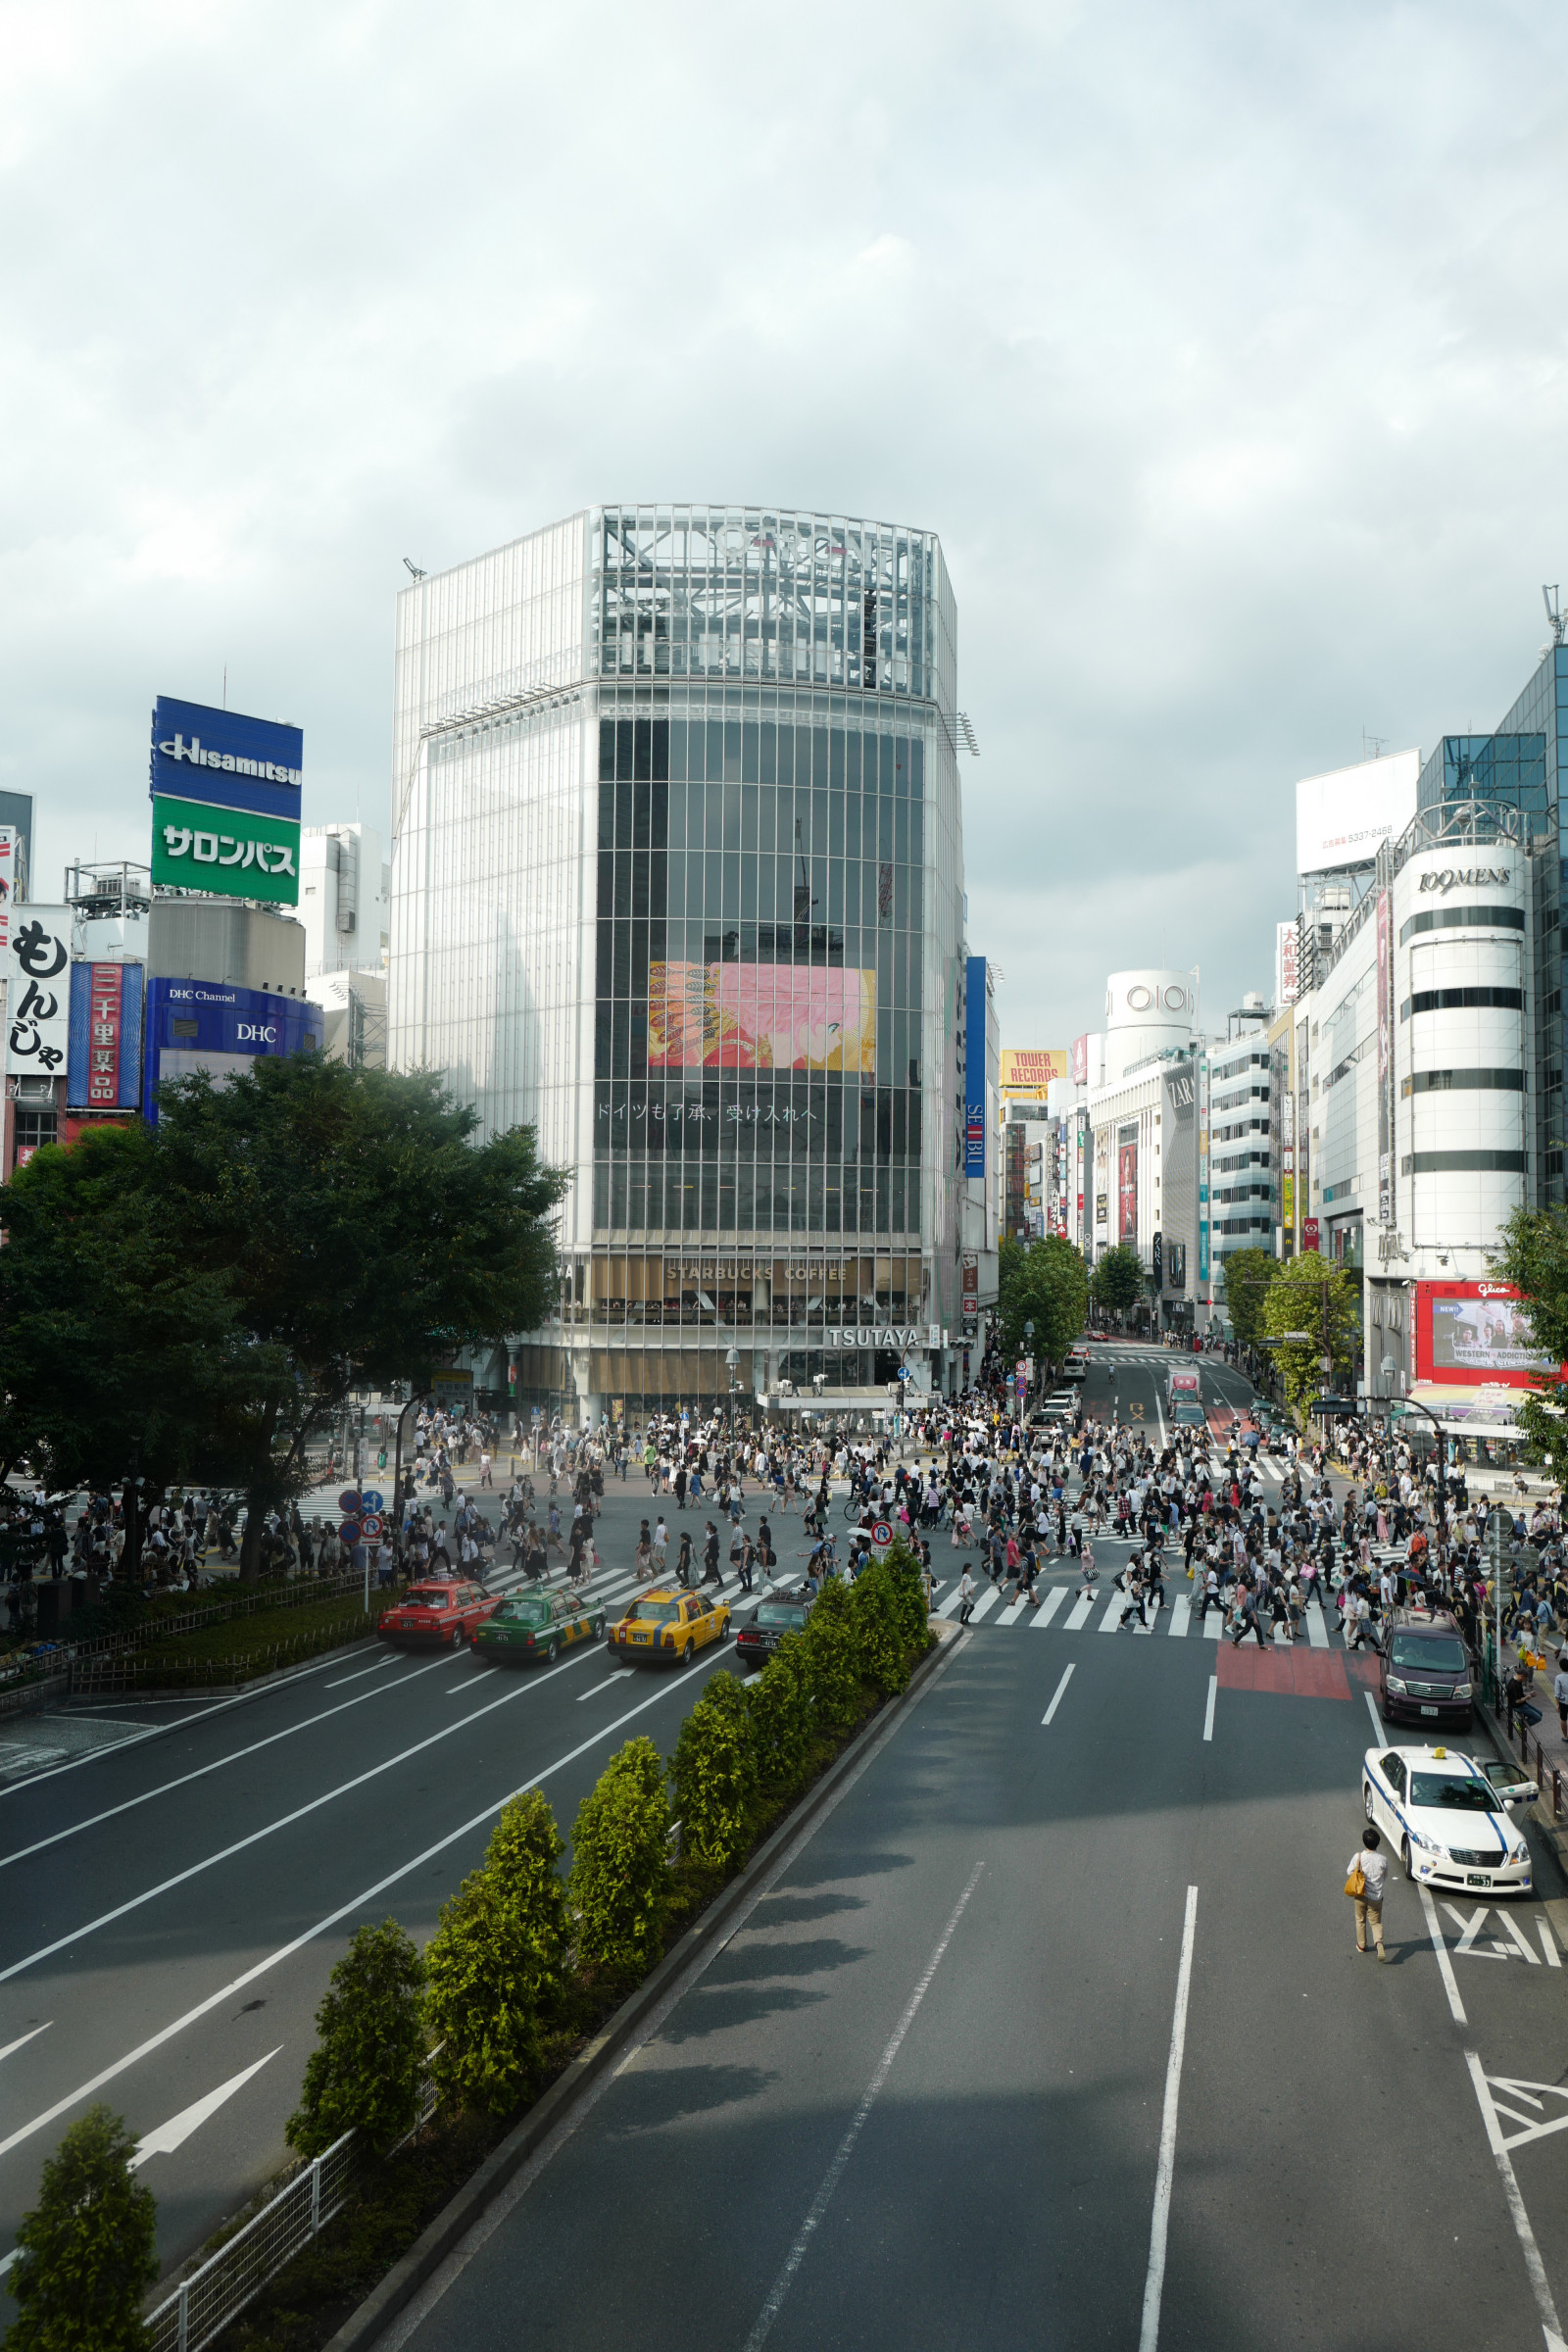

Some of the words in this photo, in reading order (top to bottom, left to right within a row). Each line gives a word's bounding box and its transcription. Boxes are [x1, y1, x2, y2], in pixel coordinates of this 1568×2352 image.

[159, 733, 302, 786] Hisamitsu
[163, 824, 296, 877] サロンパス
[1283, 928, 1298, 989] 大和証券
[10, 919, 69, 1071] もんじゃ
[170, 989, 194, 1000] DHC
[195, 990, 236, 1003] Channel
[90, 968, 118, 1100] 三千里薬品
[236, 1023, 276, 1043] DHC
[1014, 1052, 1052, 1067] TOWER
[1010, 1068, 1058, 1083] RECORDS
[967, 1104, 983, 1165] SEIBU
[666, 1267, 773, 1280] STARBUCKS
[784, 1267, 847, 1281] COFFEE
[964, 1301, 977, 1311] 本
[829, 1329, 919, 1347] TSUTAYA
[1455, 1349, 1491, 1359] WESTERN
